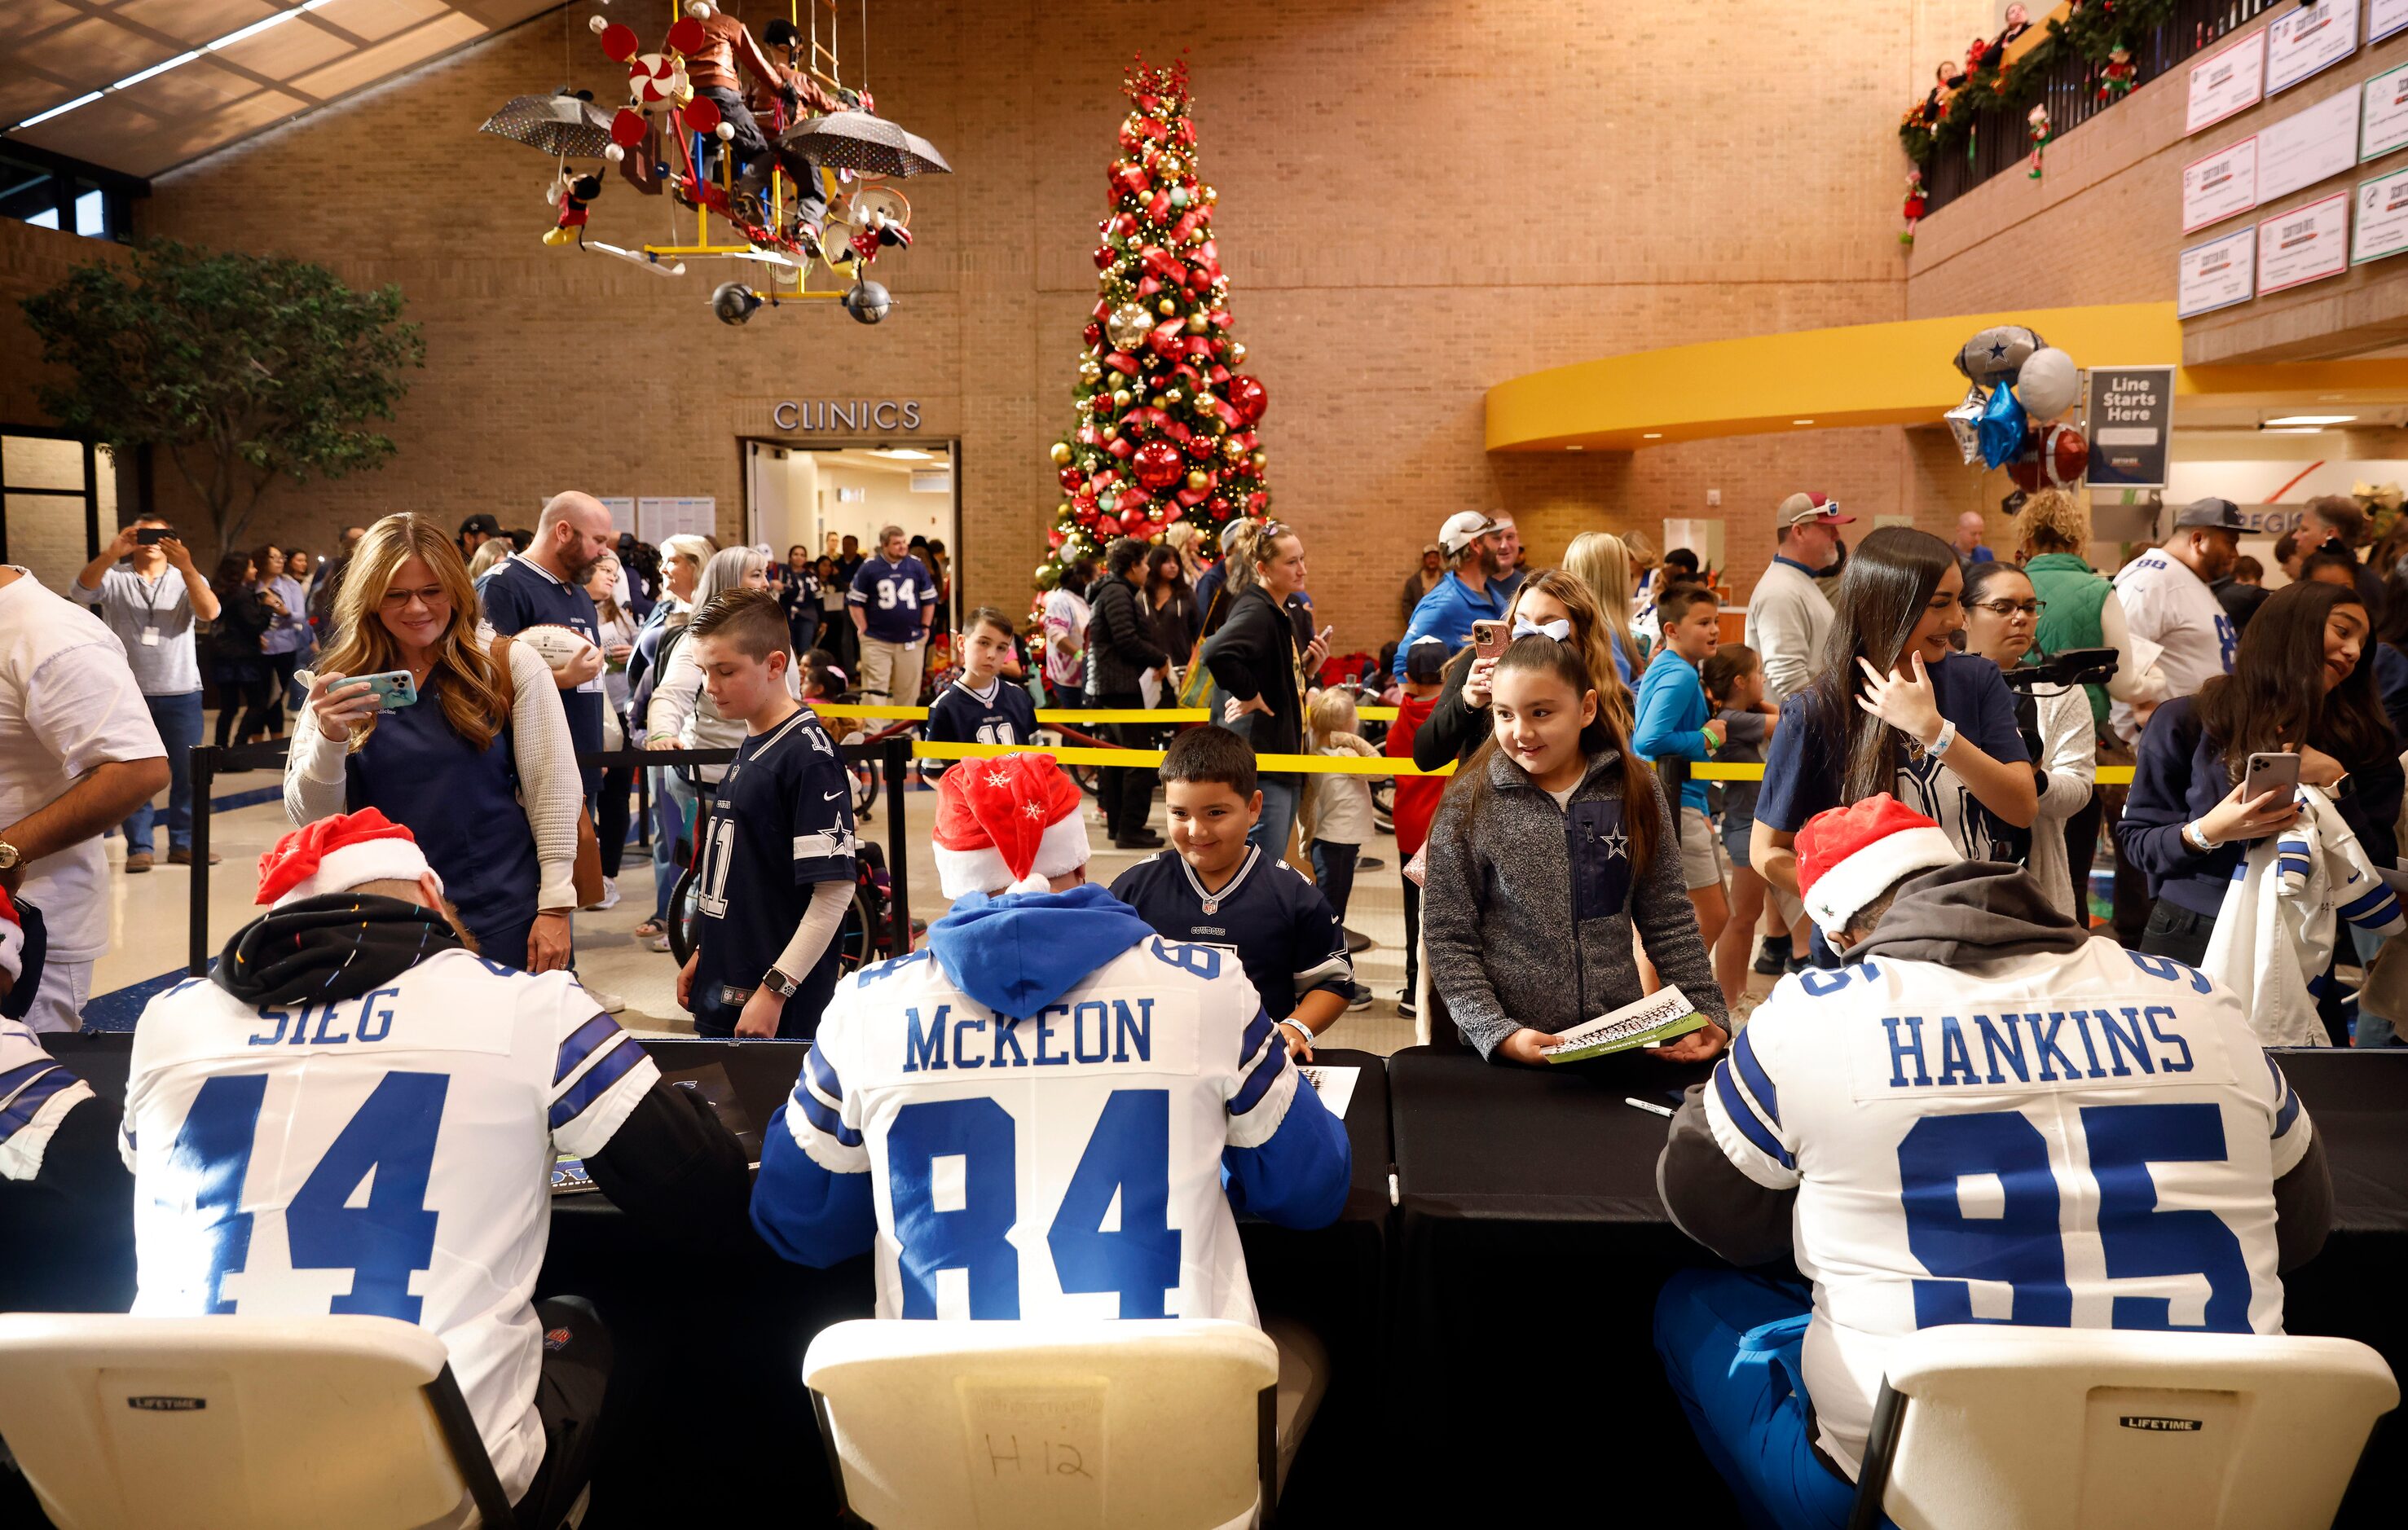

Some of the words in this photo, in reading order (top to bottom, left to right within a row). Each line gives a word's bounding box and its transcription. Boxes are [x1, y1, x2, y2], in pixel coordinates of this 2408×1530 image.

[2111, 377, 2150, 391] Line
[2102, 392, 2157, 407] Starts
[773, 401, 921, 430] CLINICS
[2107, 408, 2151, 421] Here
[2137, 559, 2168, 569] 88
[876, 578, 918, 610] 94
[1191, 926, 1226, 936] COWBOYS
[248, 987, 400, 1046] SIEG
[902, 997, 1156, 1073] McKEON
[1599, 1040, 1637, 1053] COWBOYS
[1637, 1035, 1657, 1044] 2023
[1881, 1005, 2195, 1088] HANKINS
[155, 1071, 451, 1324] 44
[887, 1088, 1182, 1321] 84
[1897, 1102, 2256, 1335] 95
[134, 1398, 196, 1409] LIFETIME
[2128, 1418, 2194, 1431] LIFETIME
[985, 1434, 1021, 1477] H
[1044, 1440, 1094, 1479] 12
